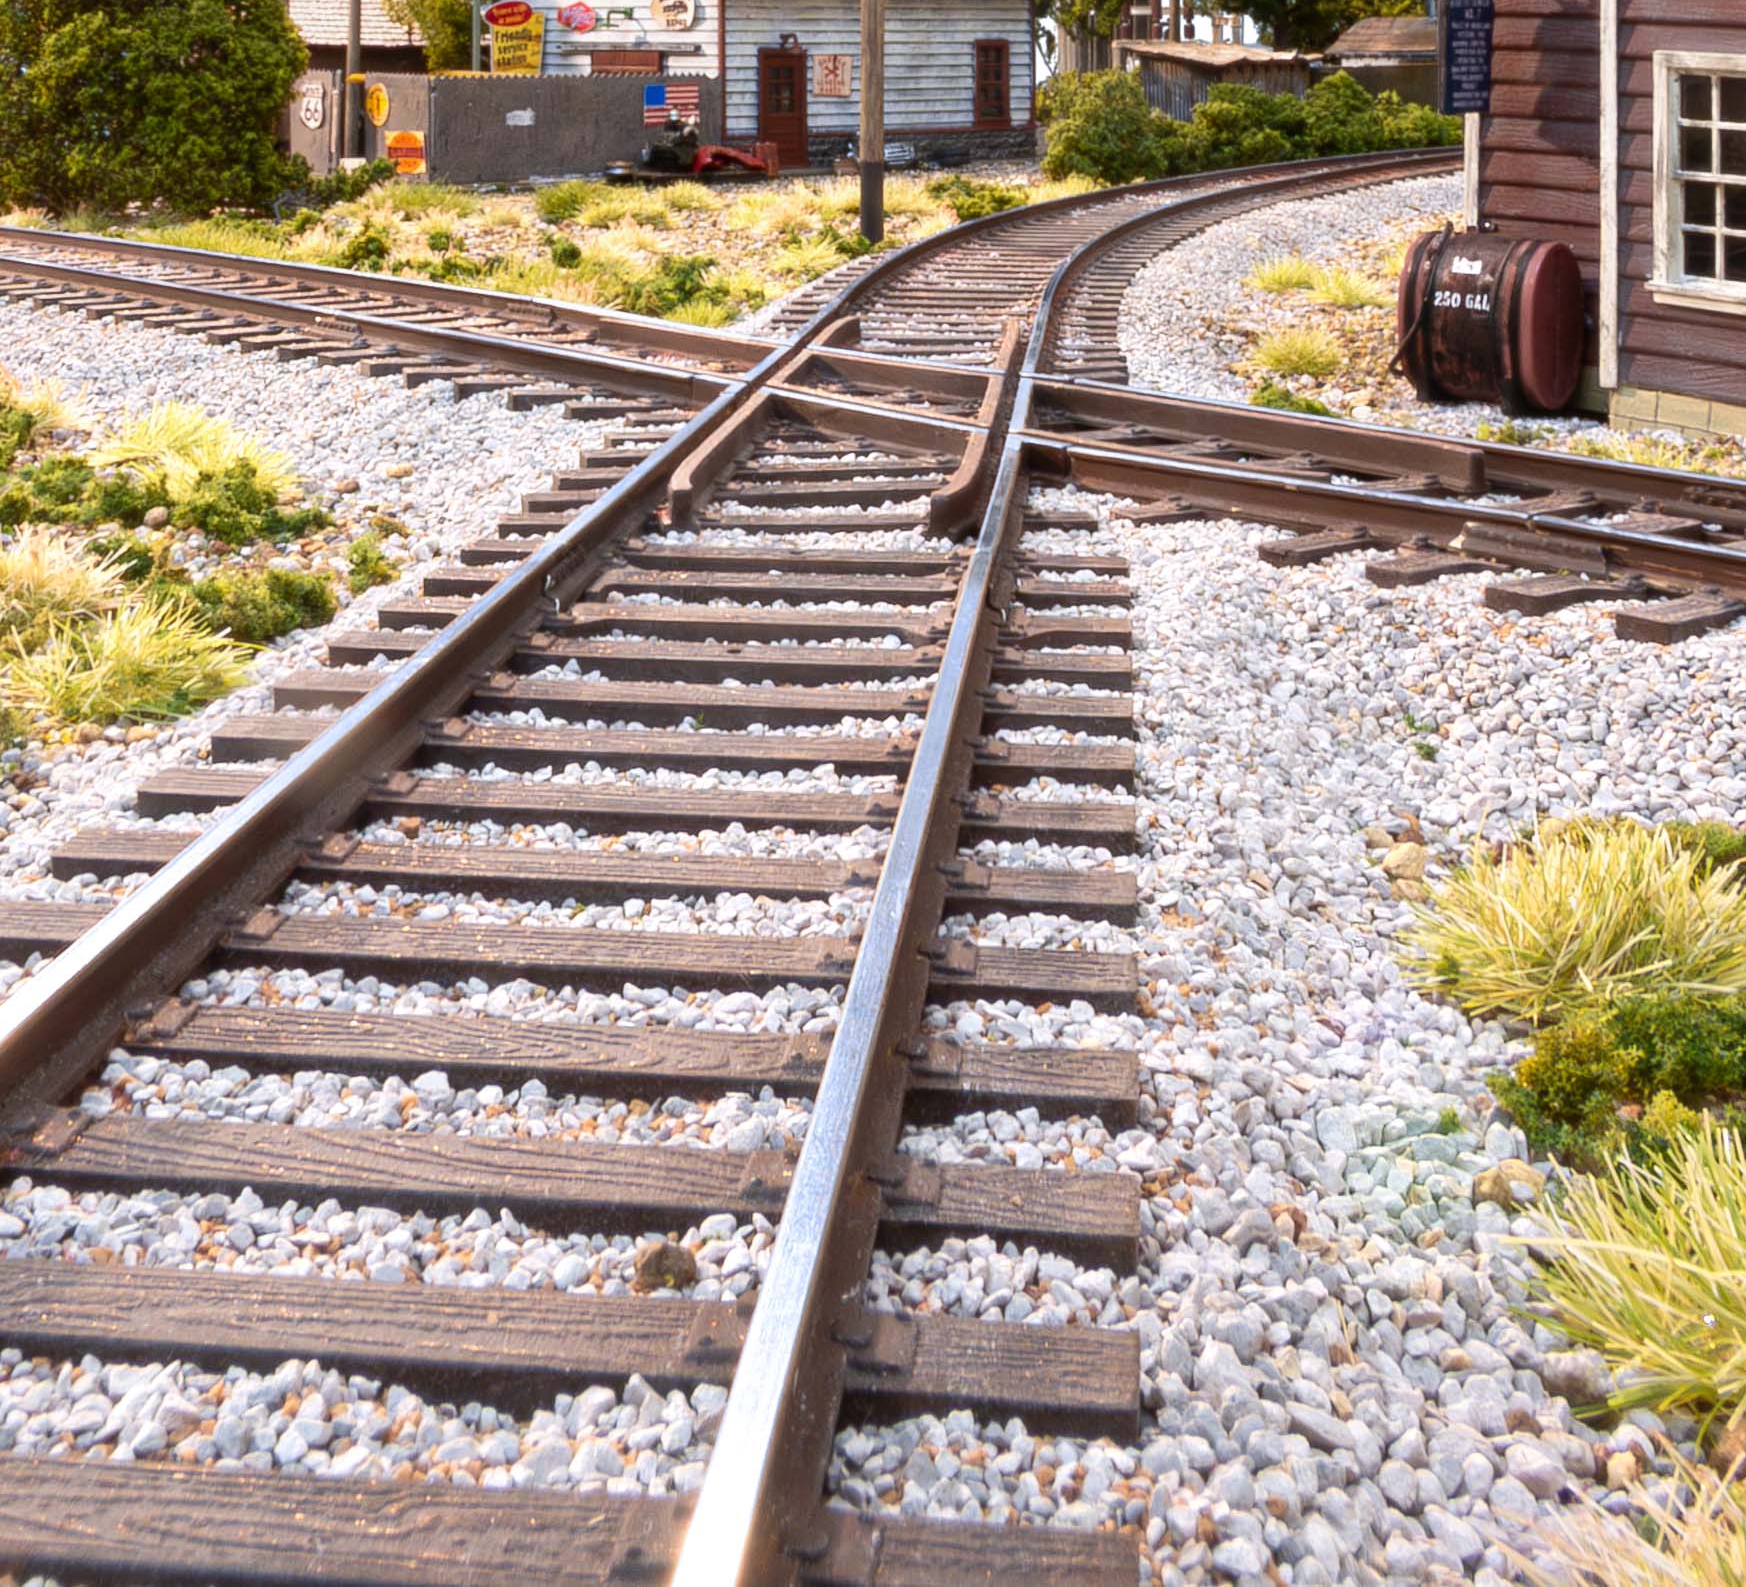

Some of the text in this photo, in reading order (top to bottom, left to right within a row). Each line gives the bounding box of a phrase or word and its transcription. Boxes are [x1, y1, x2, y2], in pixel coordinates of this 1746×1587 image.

[303, 99, 320, 123] 66
[1433, 290, 1491, 313] 250 GAL
